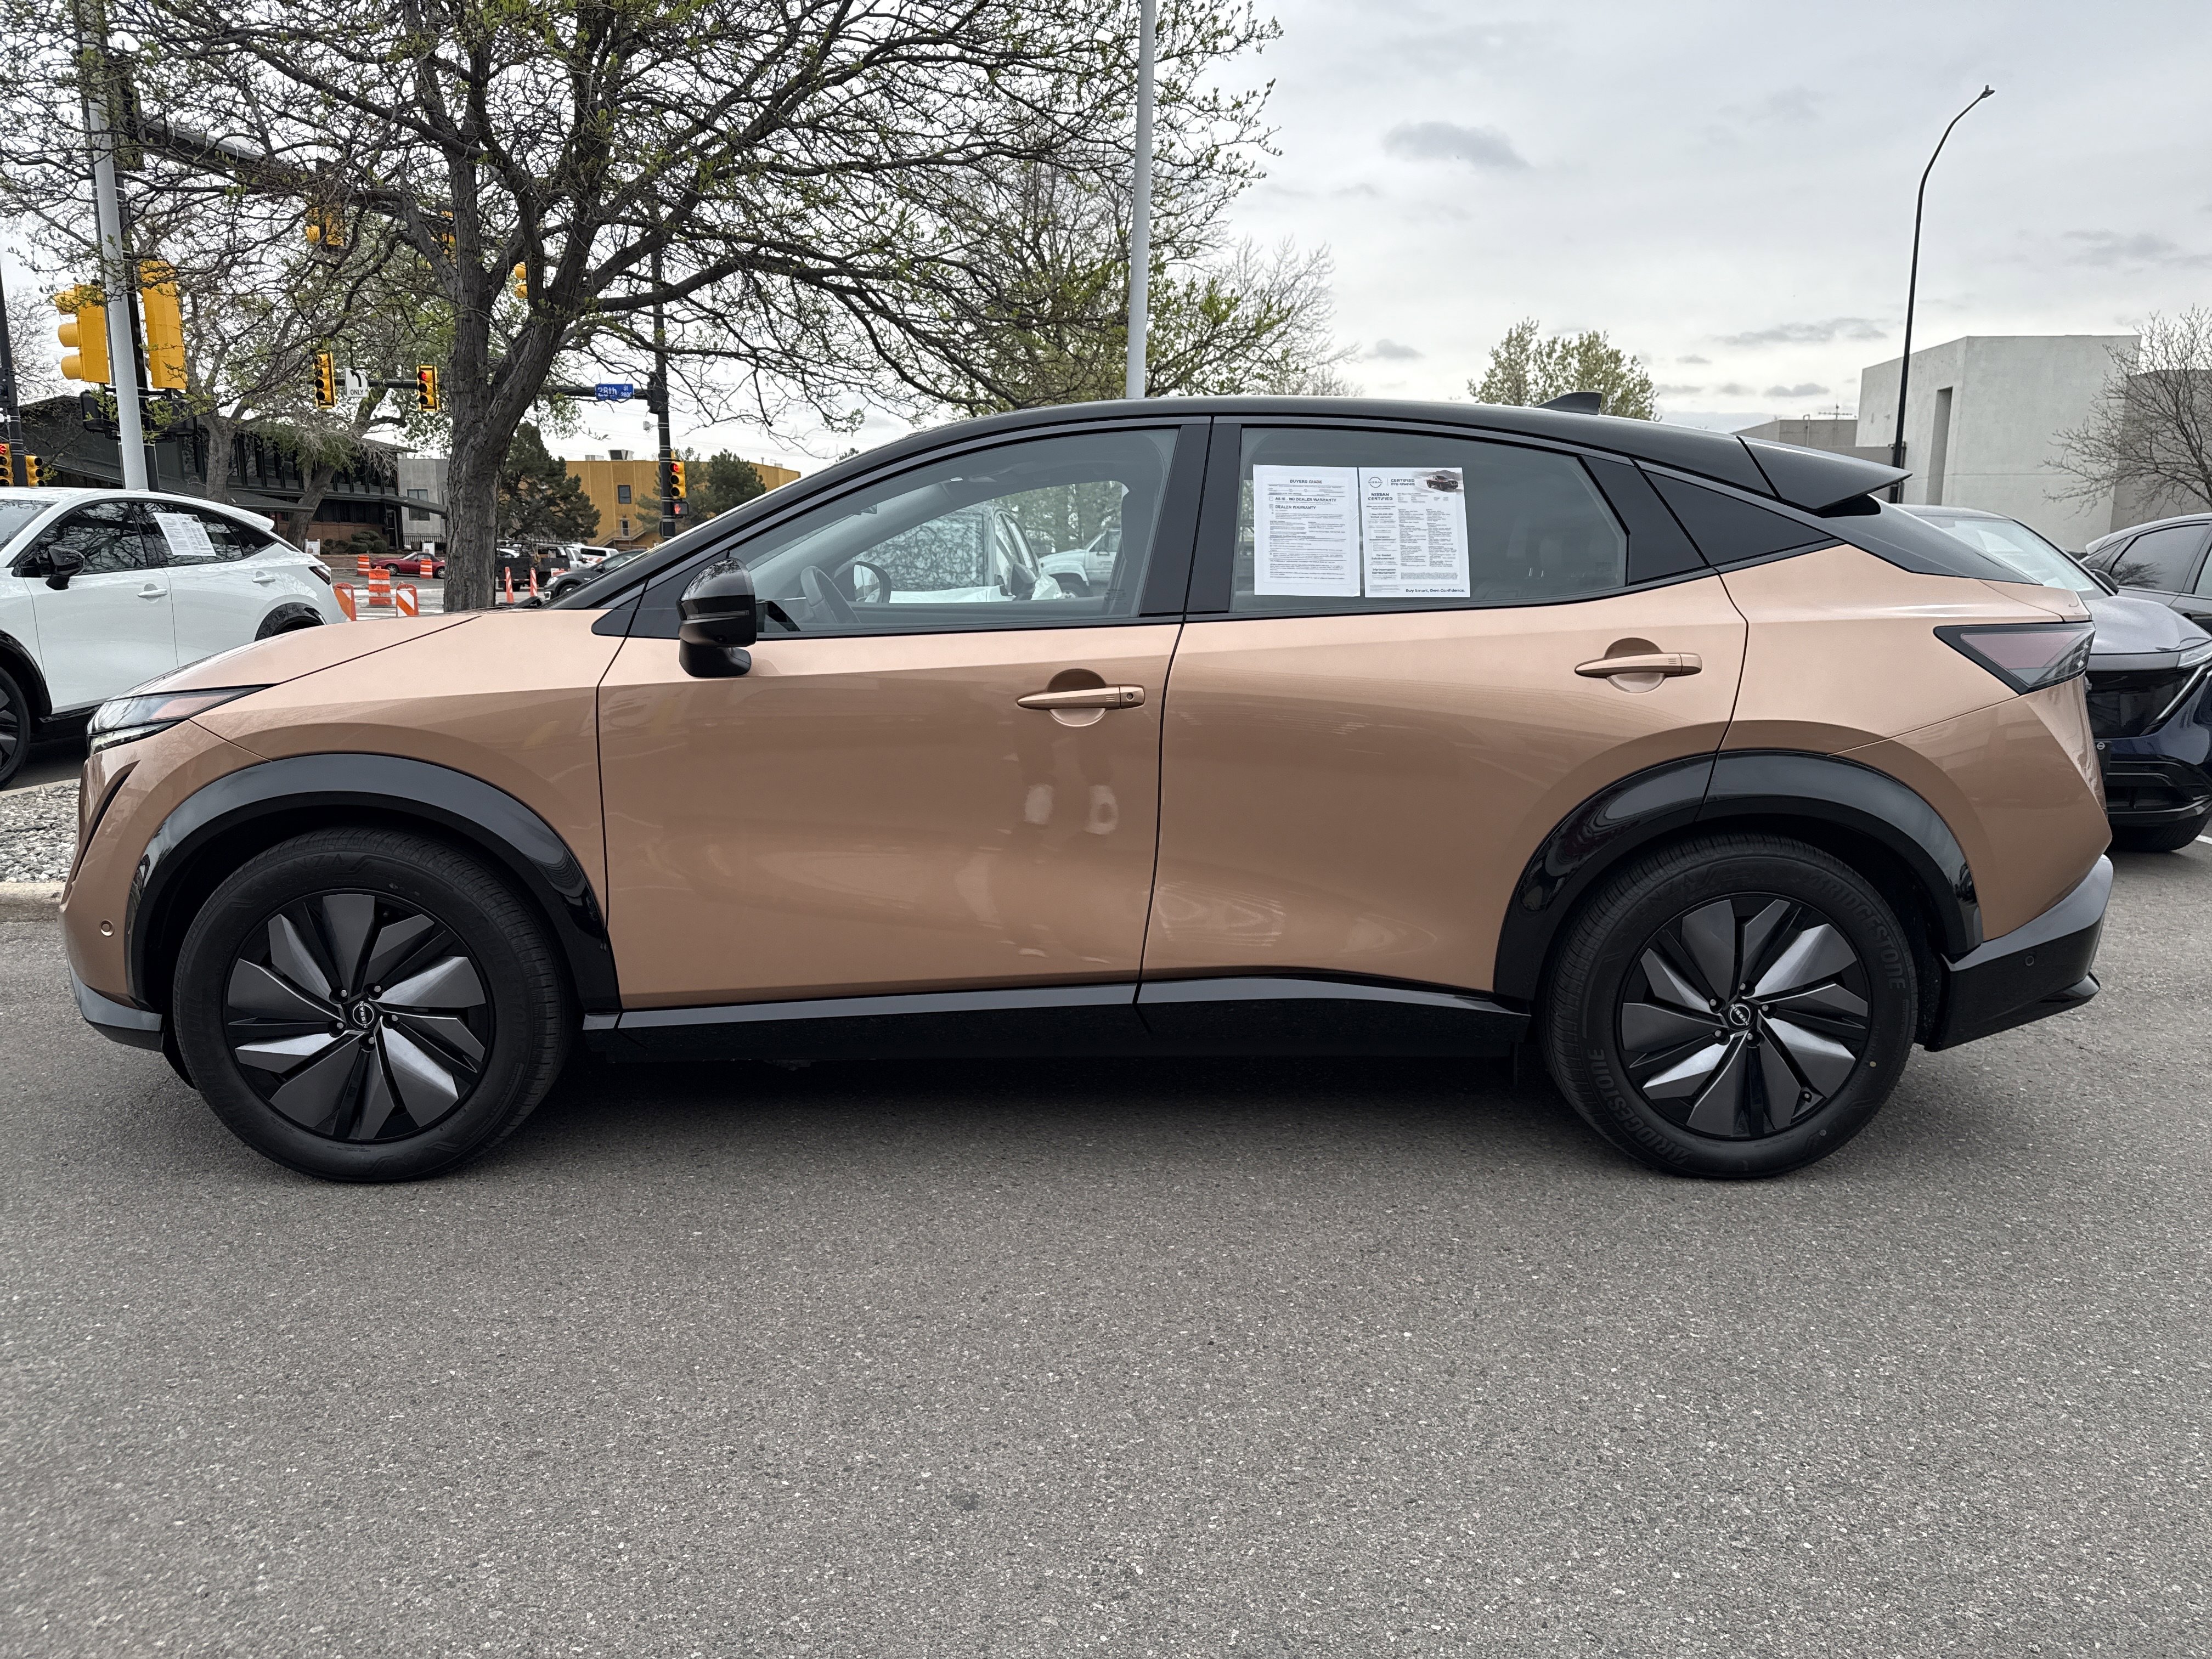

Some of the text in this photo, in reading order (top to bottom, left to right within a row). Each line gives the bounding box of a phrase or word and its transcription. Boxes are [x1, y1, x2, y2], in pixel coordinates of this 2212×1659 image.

[597, 386, 617, 397] 28th
[1804, 871, 1907, 990] BRIDGESTONE
[359, 1001, 368, 1029] NISSAN
[1730, 1003, 1750, 1026] NISSAN
[1587, 1047, 1691, 1164] BRIDGESTONE
